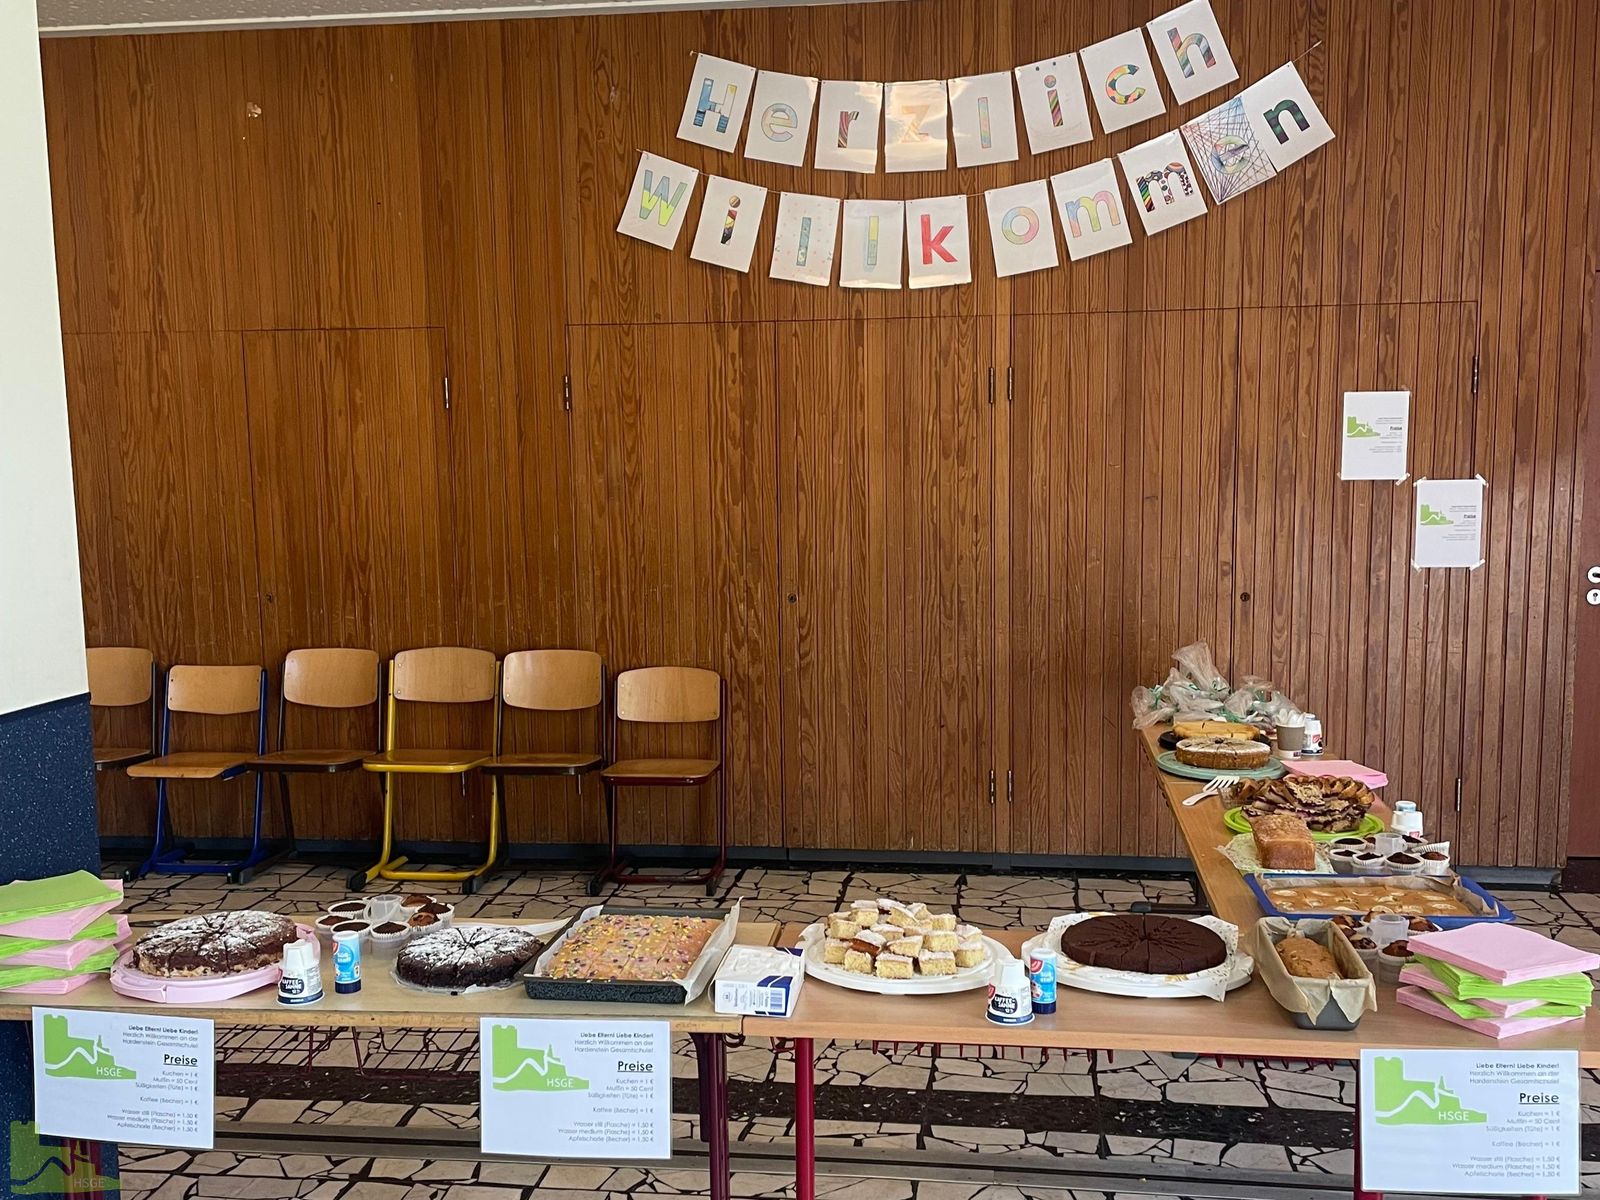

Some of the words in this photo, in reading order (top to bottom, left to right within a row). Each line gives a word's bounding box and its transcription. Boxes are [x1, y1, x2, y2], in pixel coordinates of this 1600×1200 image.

[693, 27, 1217, 149] Herzlich
[644, 81, 1310, 267] Willkommen
[164, 1054, 198, 1066] Preise
[96, 1067, 122, 1077] HSGE
[618, 1061, 653, 1072] Preise
[547, 1078, 574, 1088] HSGE
[1519, 1093, 1559, 1104] Preise
[1438, 1111, 1469, 1121] HSGE
